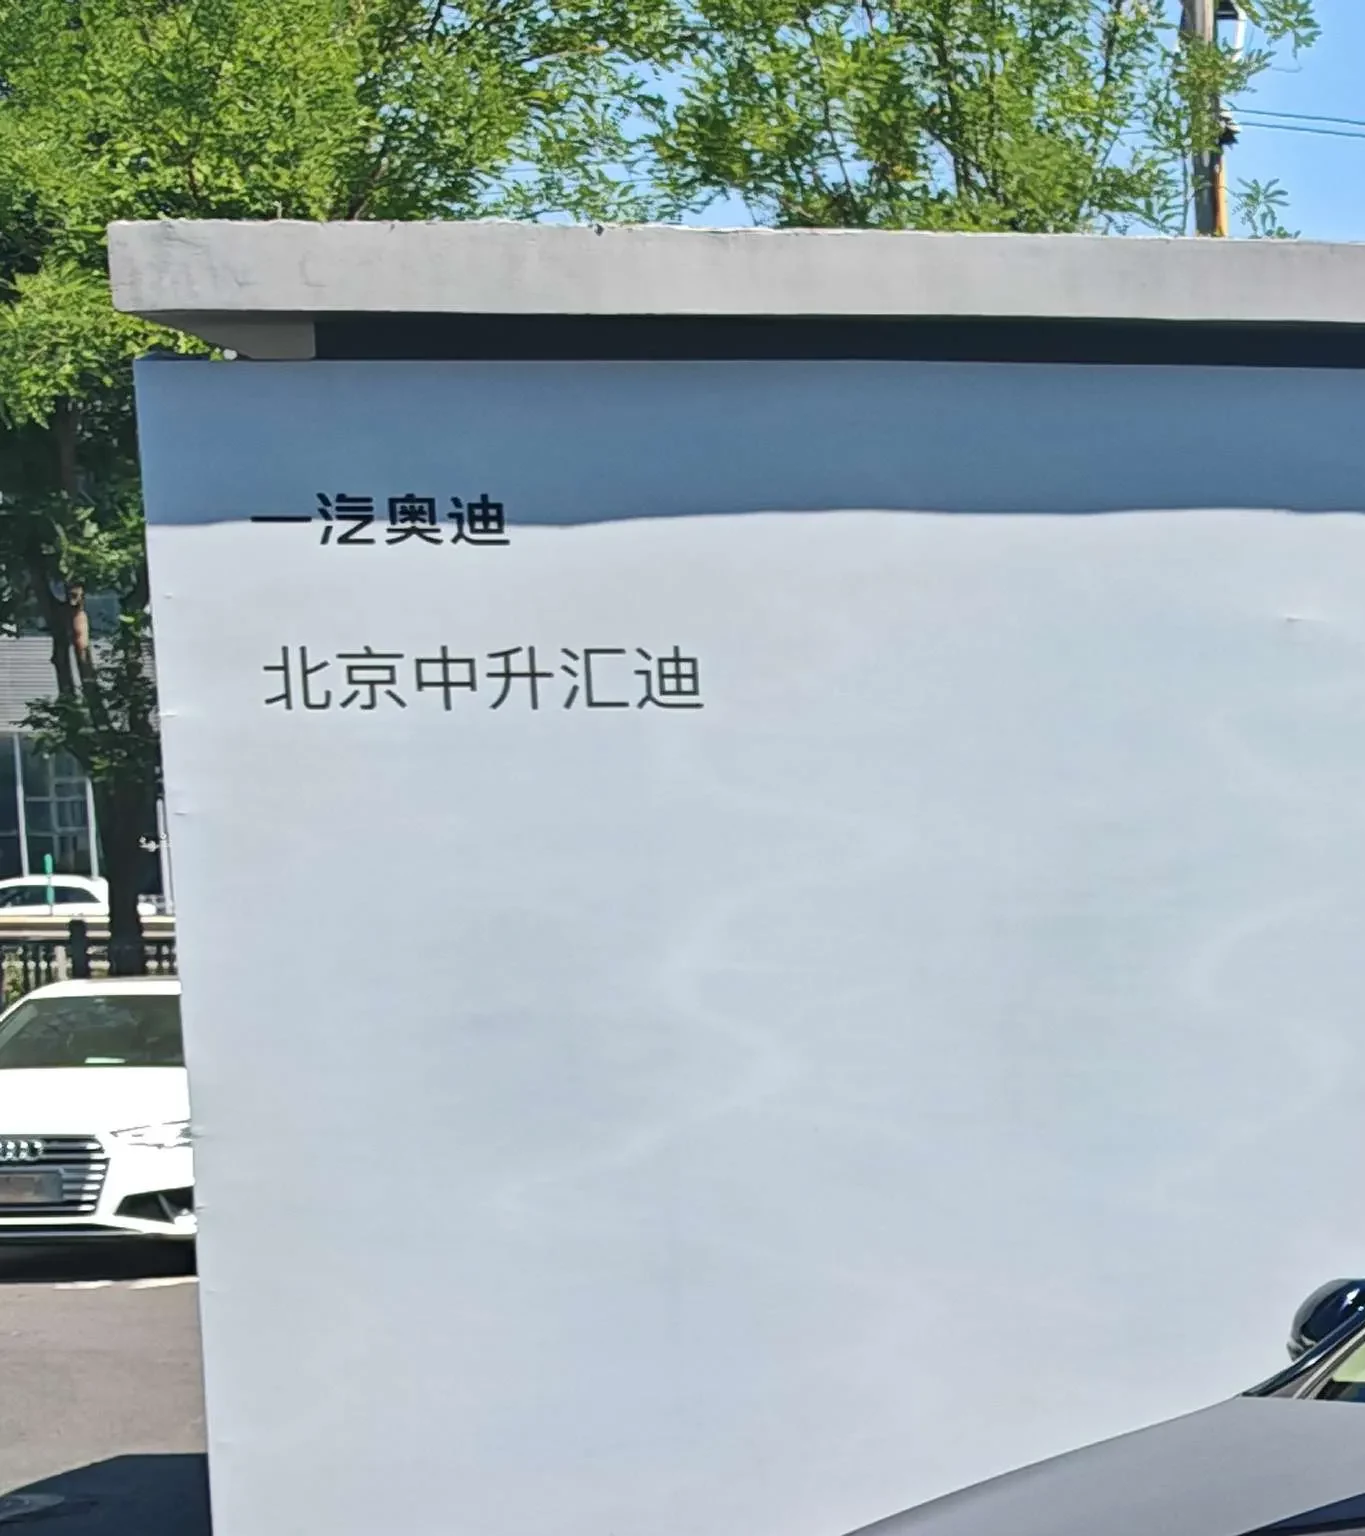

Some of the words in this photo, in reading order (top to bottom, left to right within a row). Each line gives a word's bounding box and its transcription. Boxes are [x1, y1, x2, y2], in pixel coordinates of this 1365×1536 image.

[250, 492, 511, 546] 一汽奥迪
[263, 645, 704, 712] 北京中升汇迪
